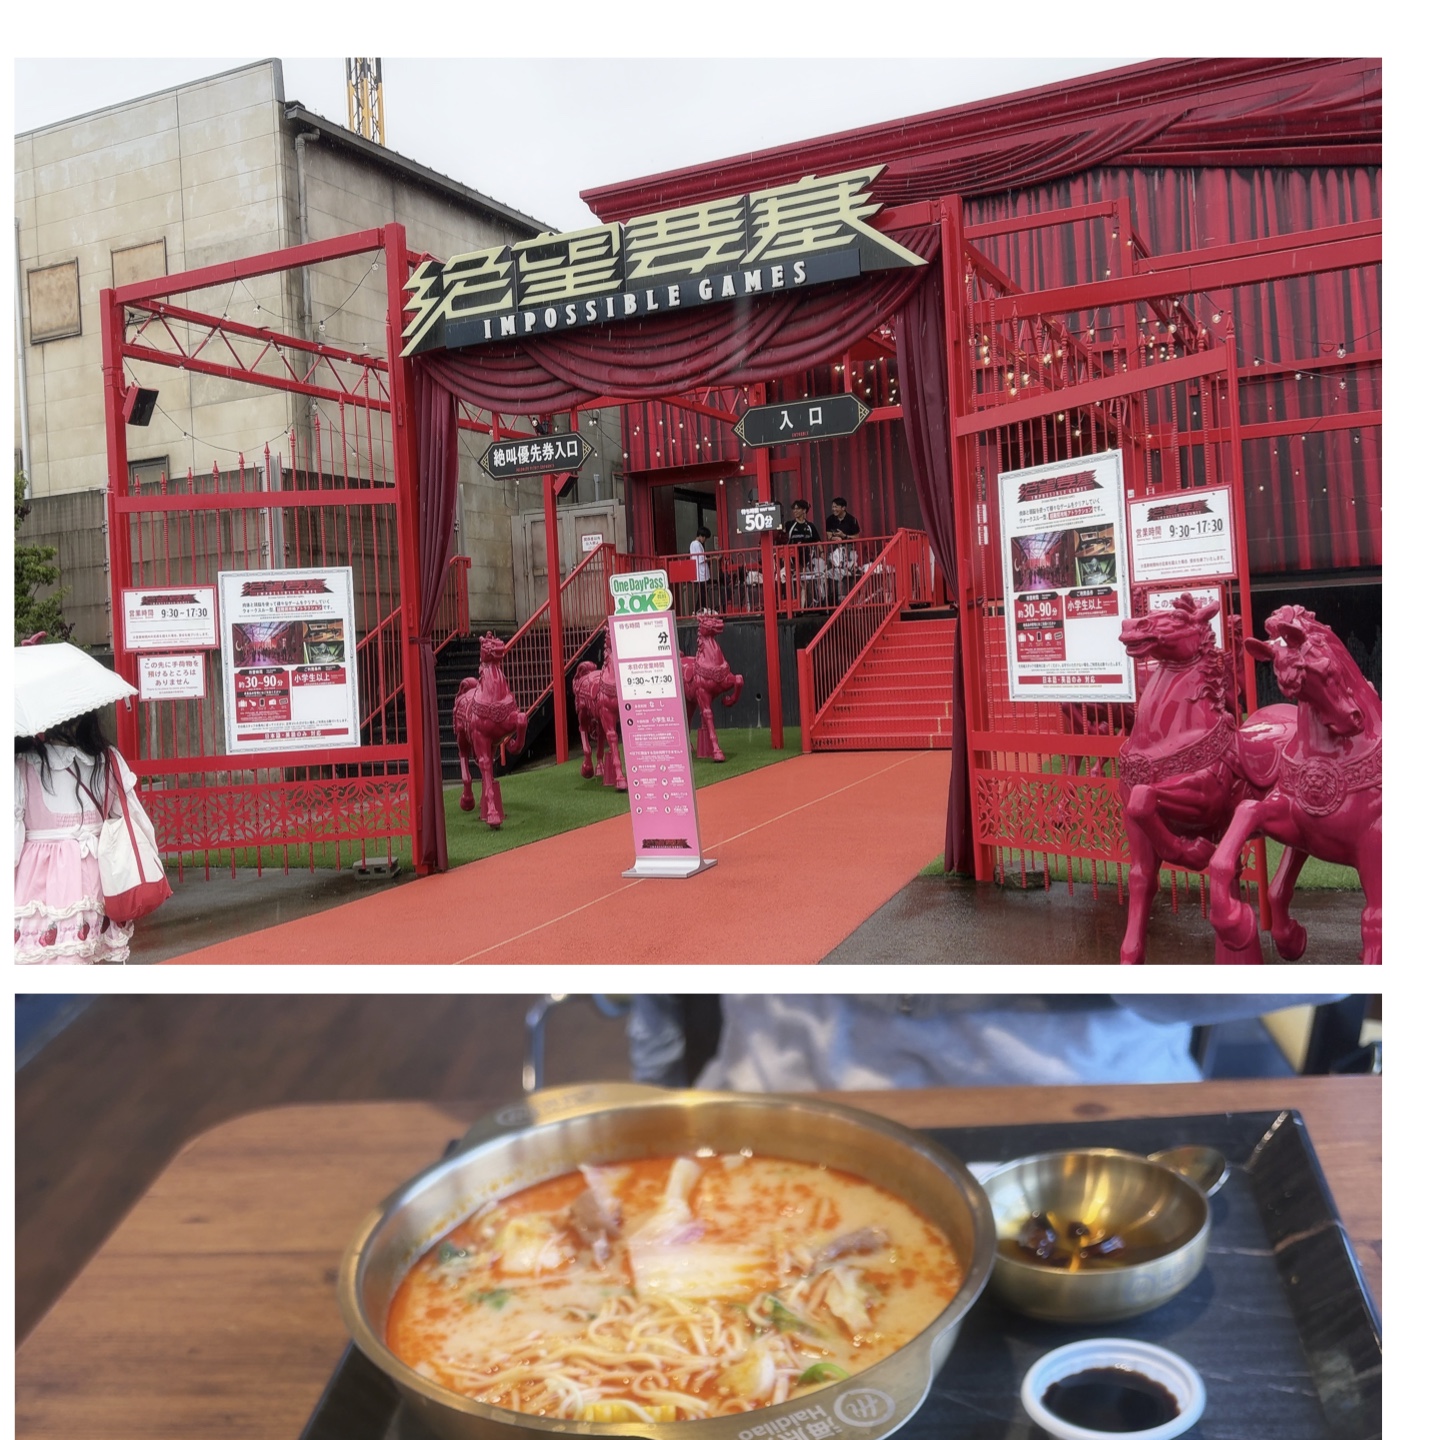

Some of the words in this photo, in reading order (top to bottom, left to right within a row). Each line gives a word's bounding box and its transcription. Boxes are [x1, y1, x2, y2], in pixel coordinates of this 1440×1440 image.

[483, 286, 682, 340] IMPOSSIBLE
[698, 261, 808, 301] GAMES
[779, 406, 823, 430] 入口
[493, 440, 578, 467] 絶叫優先券入口
[629, 593, 658, 613] OK
[1067, 598, 1103, 612] 小学生以上
[129, 609, 154, 617] 営業時間
[658, 631, 668, 644] 分
[155, 678, 189, 686] ありません
[294, 673, 330, 683] 小学生以上
